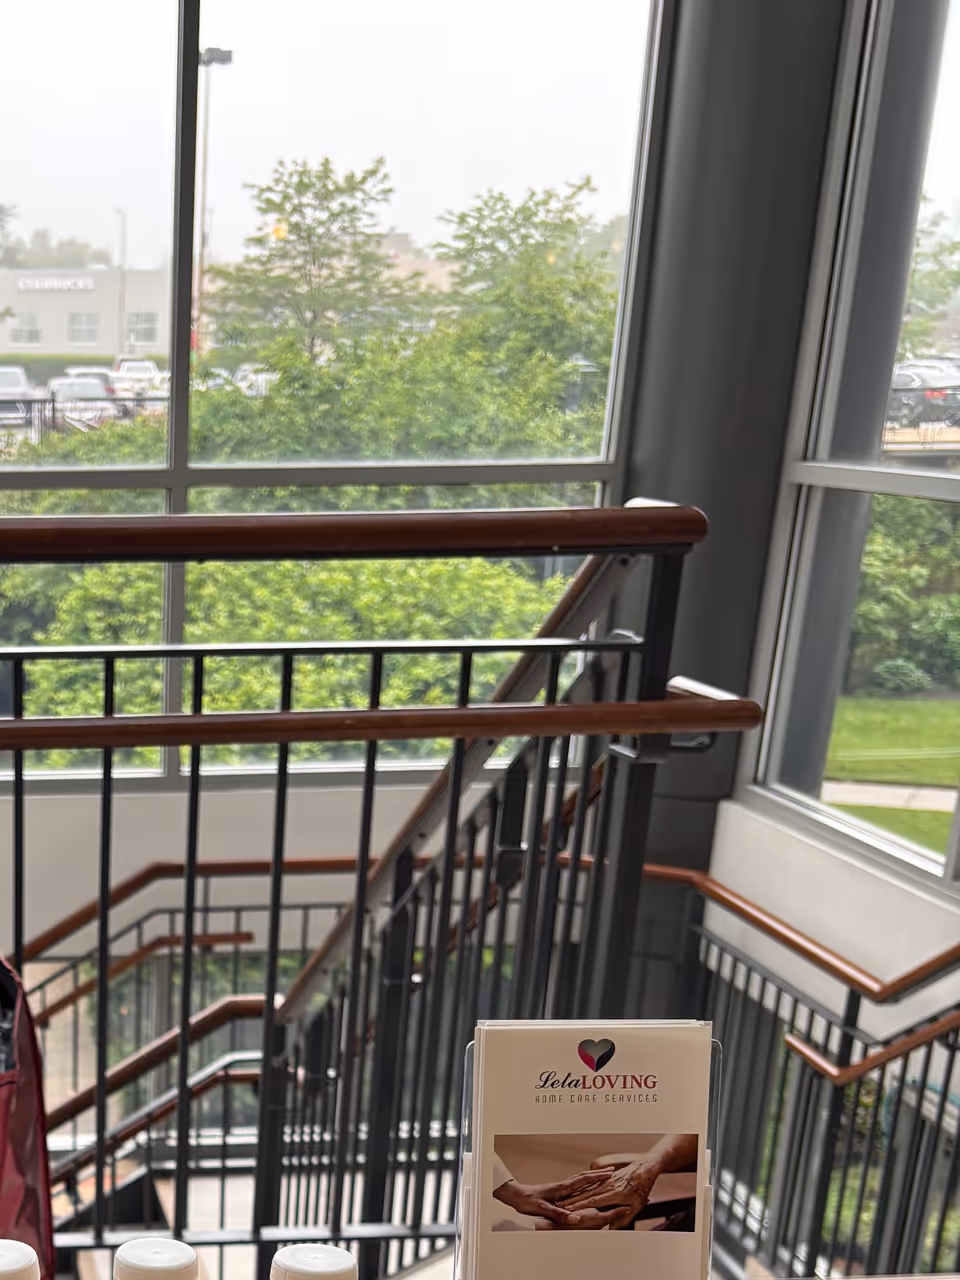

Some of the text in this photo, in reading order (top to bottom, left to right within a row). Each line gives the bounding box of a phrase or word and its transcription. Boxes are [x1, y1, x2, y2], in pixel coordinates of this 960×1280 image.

[535, 1094, 658, 1104] HOME CARE SERVICES
